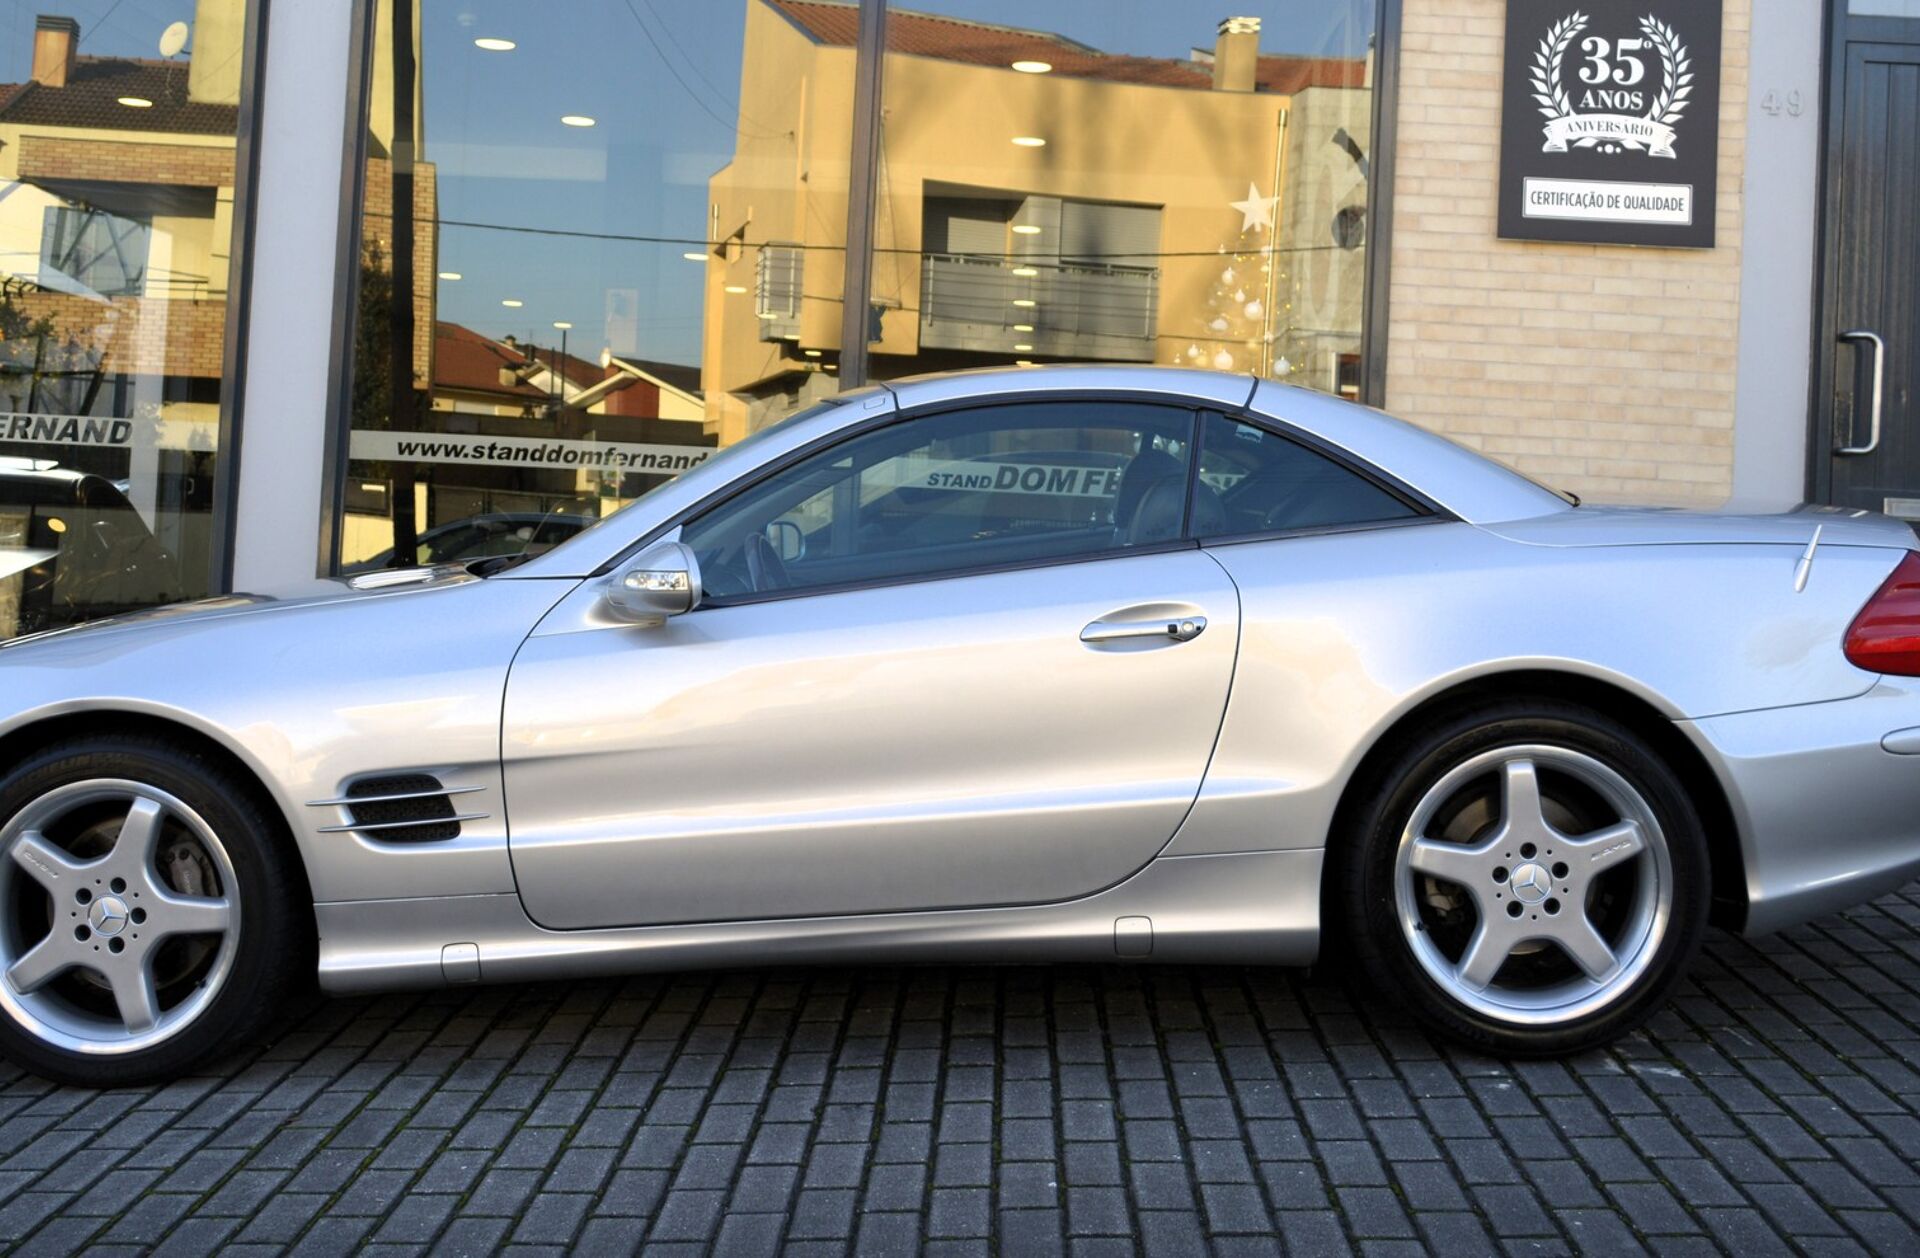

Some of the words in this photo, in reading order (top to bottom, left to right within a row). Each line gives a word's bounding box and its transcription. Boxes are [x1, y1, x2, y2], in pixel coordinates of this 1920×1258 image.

[1579, 89, 1644, 111] ANOS
[1760, 89, 1805, 118] 49
[1566, 119, 1654, 137] ANIVERSÁRIO
[1530, 190, 1604, 209] CERTIFICAÇÃO
[1606, 194, 1621, 209] DE
[1623, 195, 1685, 212] QUALIDADE
